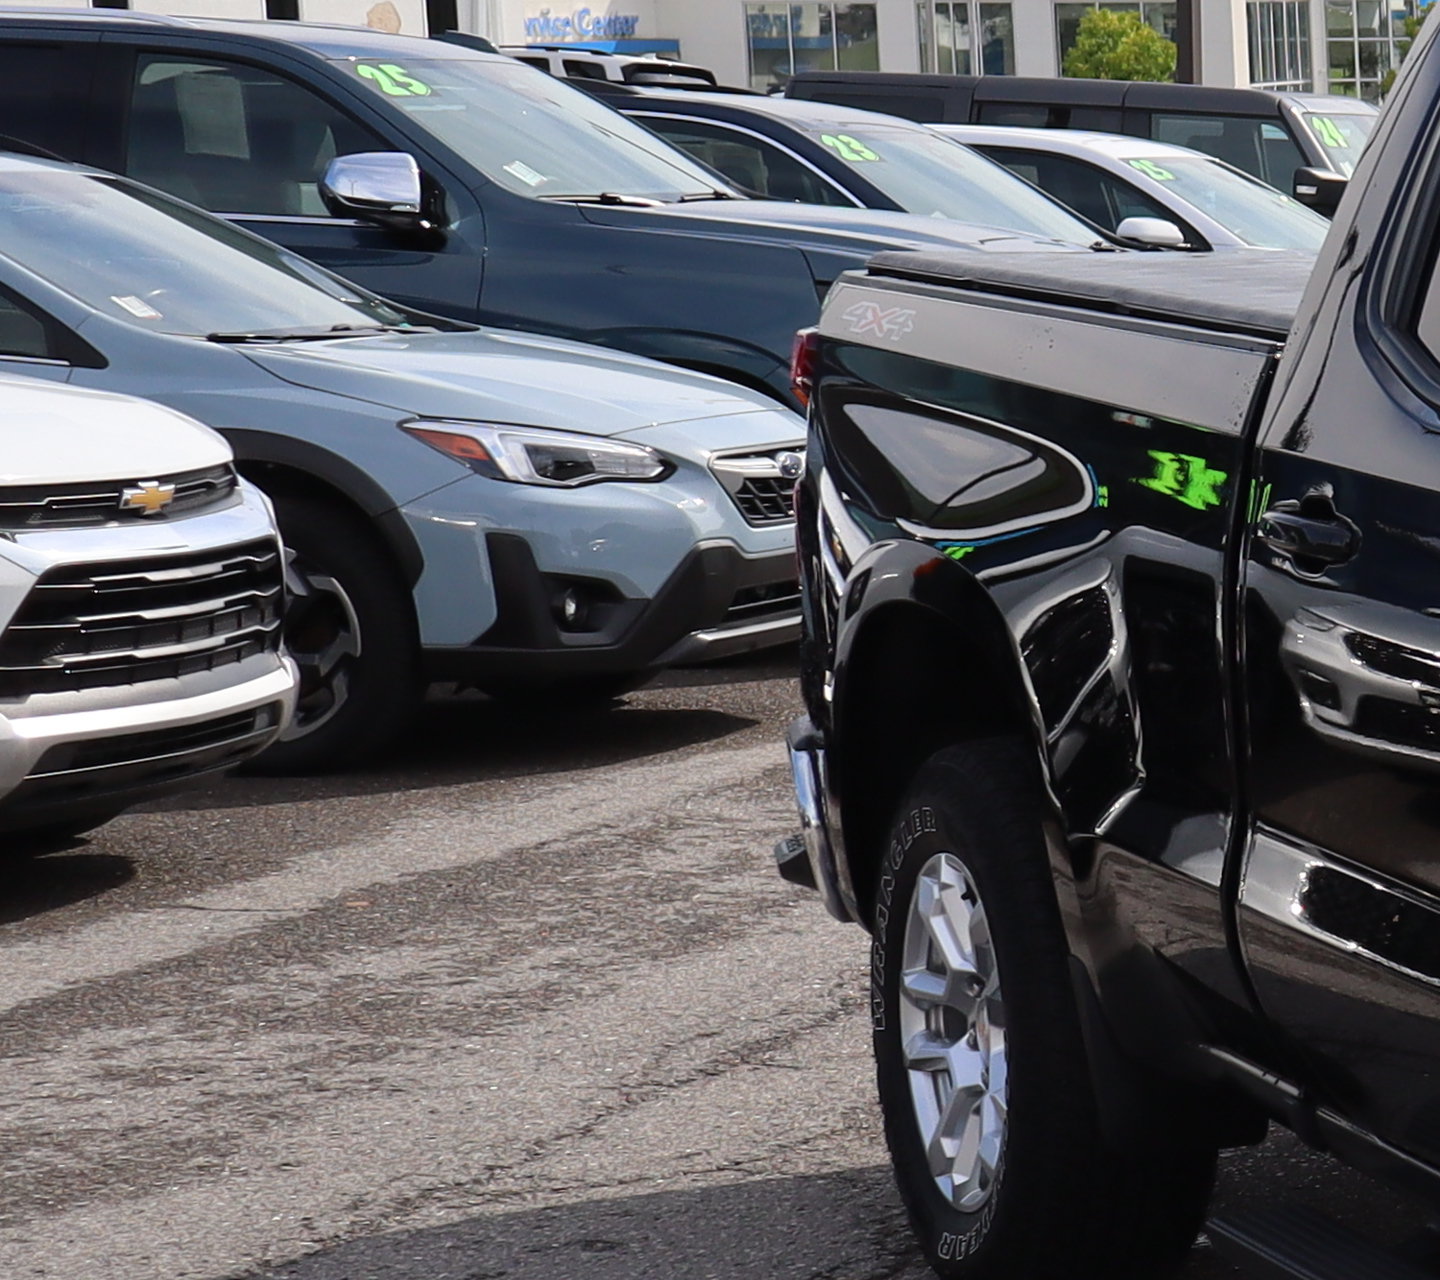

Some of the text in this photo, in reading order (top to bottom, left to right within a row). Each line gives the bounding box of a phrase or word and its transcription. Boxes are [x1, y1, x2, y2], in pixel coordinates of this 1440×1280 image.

[575, 6, 640, 38] Center
[356, 63, 433, 97] 25
[821, 134, 880, 161] 23
[1128, 158, 1177, 182] 25
[873, 805, 938, 1031] WRANGLER
